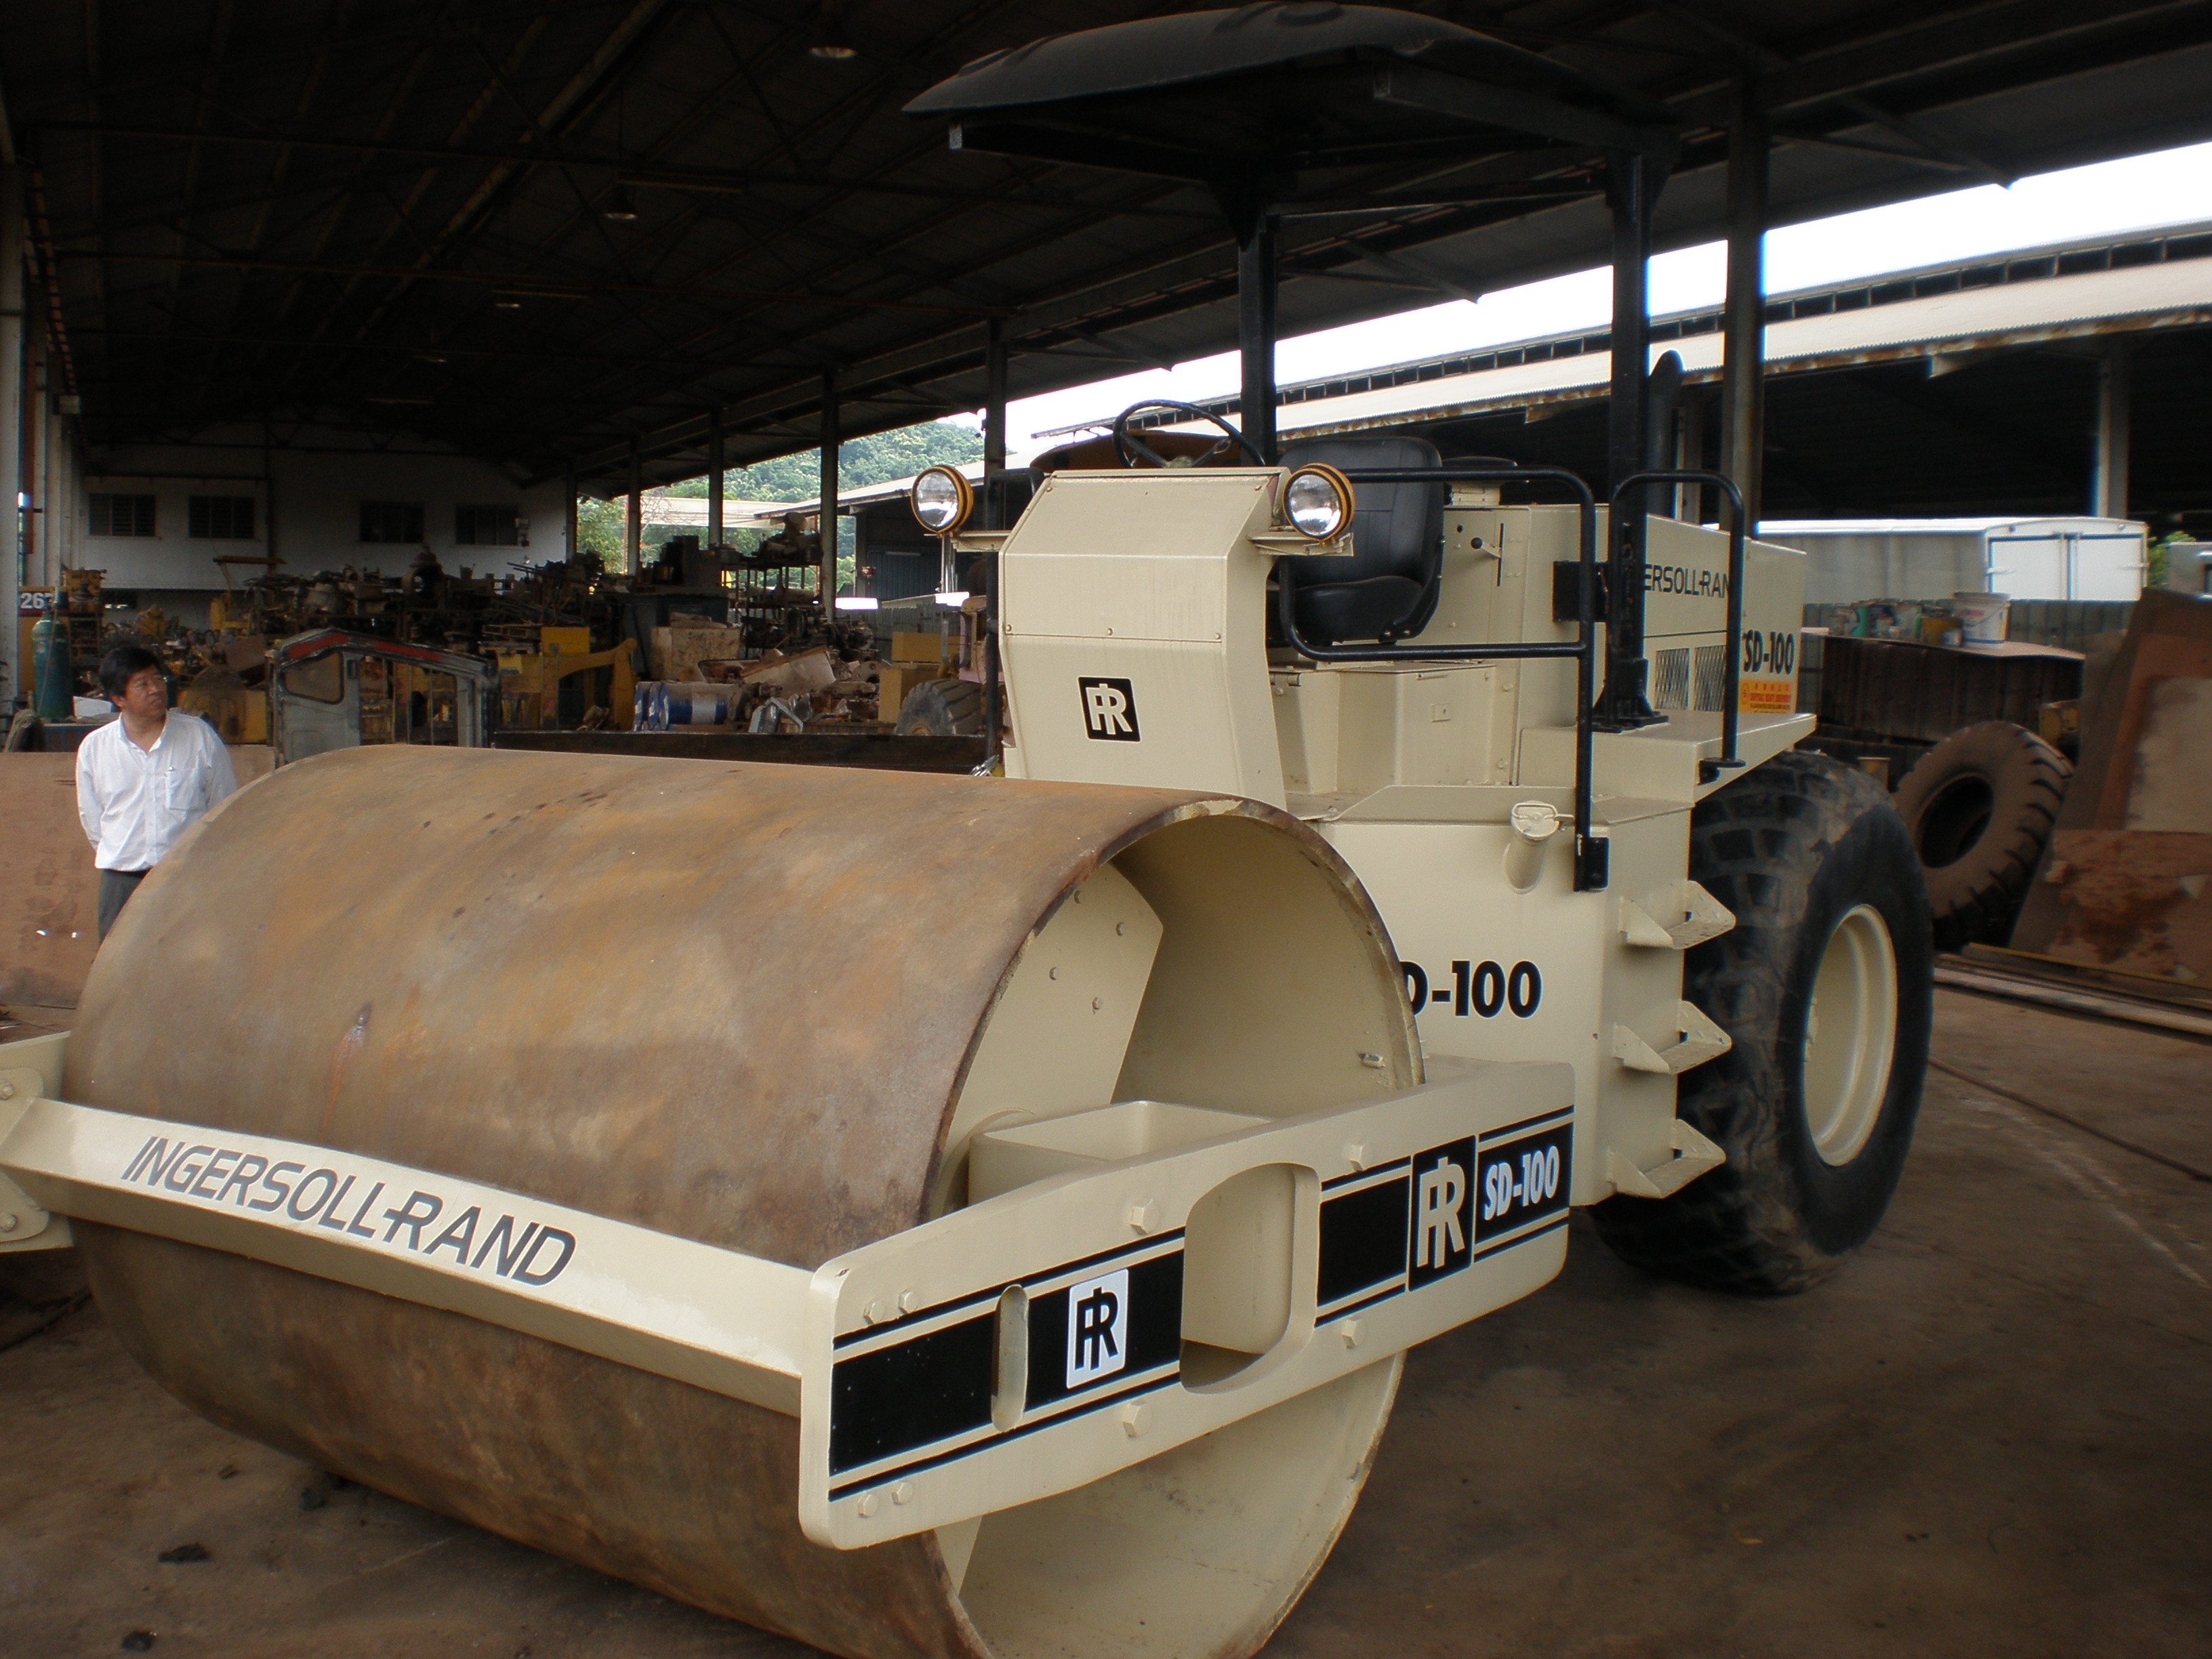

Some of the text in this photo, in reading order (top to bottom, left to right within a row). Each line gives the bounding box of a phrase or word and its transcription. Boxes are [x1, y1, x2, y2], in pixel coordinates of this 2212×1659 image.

[1743, 630, 1795, 675] SD-100
[121, 1136, 576, 1286] INGERSOLL-RAND
[1484, 1145, 1560, 1221] SD-100
